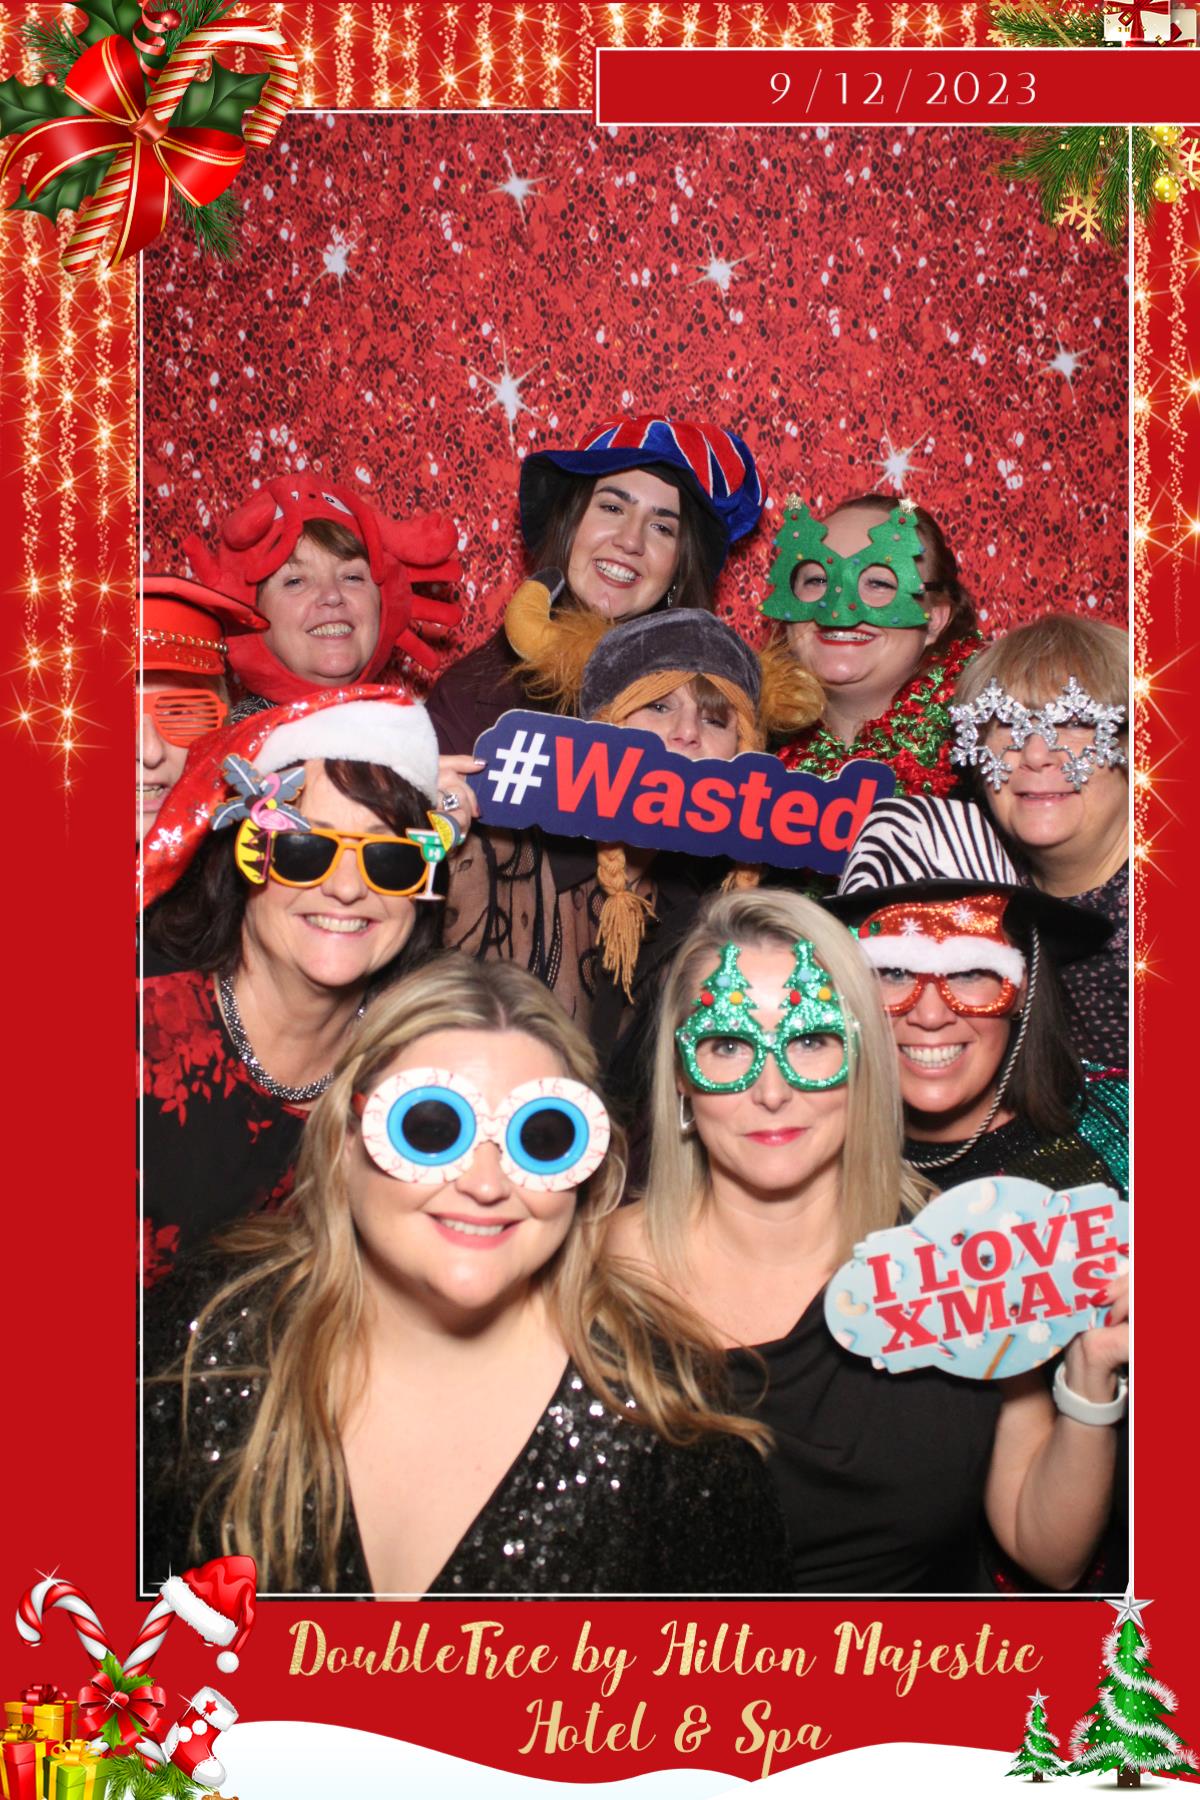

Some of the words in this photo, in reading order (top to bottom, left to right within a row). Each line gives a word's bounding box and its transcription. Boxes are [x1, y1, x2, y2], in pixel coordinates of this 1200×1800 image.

[487, 729, 878, 853] #Wasted
[867, 1253, 897, 1303] I
[914, 1205, 1119, 1294] LOVE
[875, 1257, 1118, 1354] XMAS
